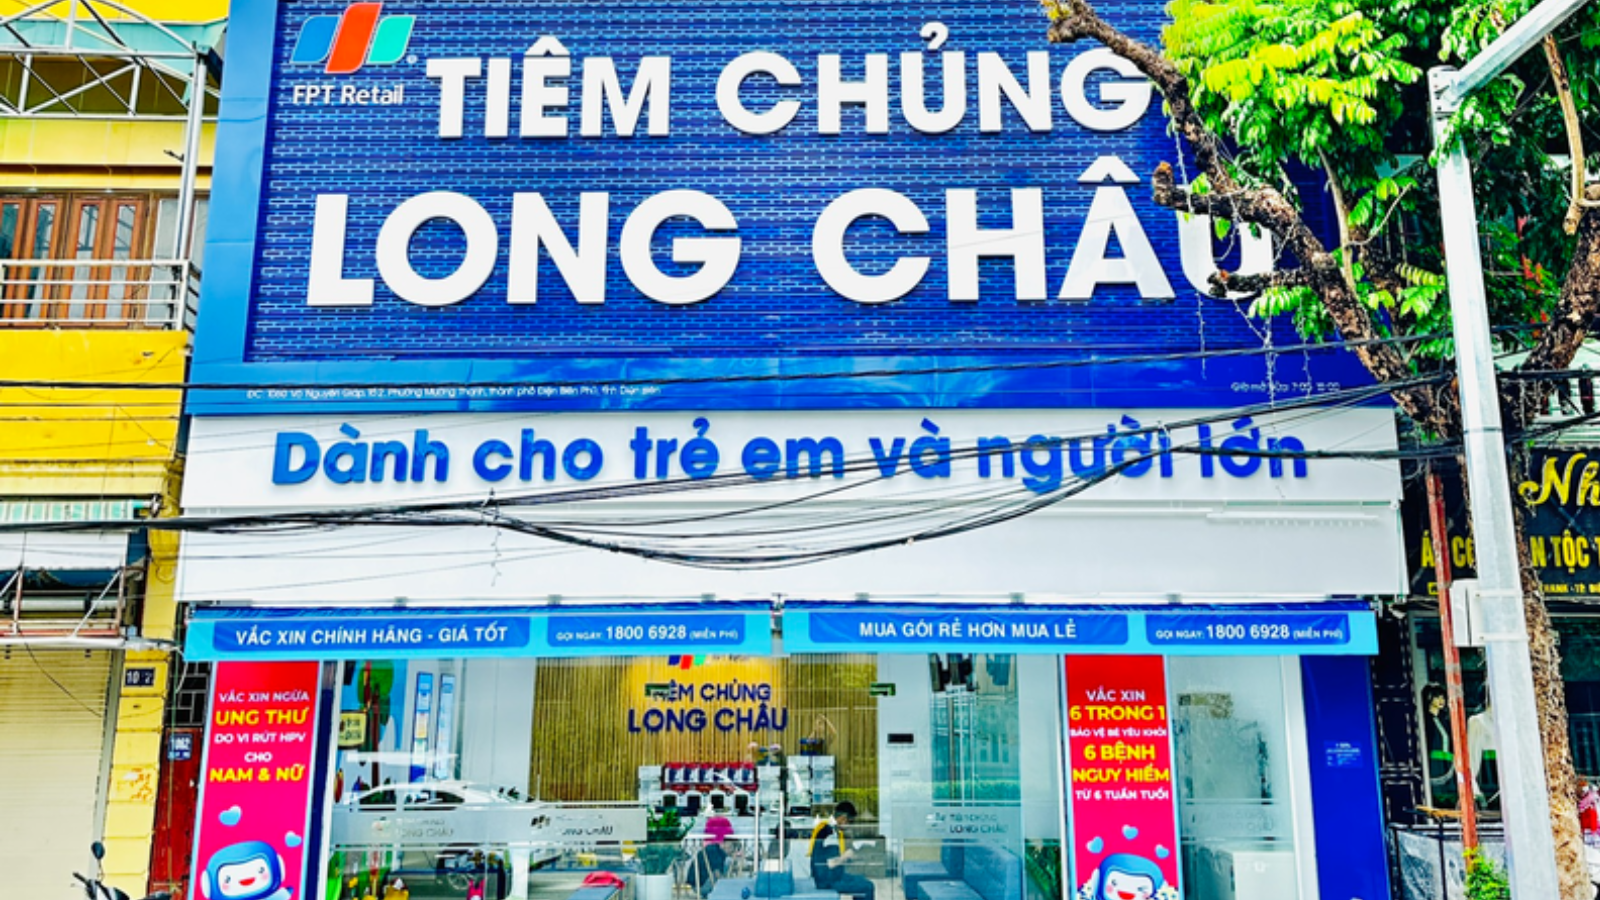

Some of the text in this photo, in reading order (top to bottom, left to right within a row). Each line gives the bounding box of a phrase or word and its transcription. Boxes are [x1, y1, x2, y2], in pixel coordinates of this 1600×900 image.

[426, 21, 1154, 138] TIÊM CHỦNG
[293, 83, 404, 104] FPT Retail
[307, 155, 1273, 307] LONG CHÂU
[272, 414, 1307, 495] Dành cho trẻ em và người lớn
[1551, 529, 1590, 573] TỘC
[236, 622, 272, 645] VẮC
[276, 629, 306, 644] XIN
[311, 626, 366, 644] CHÍNH
[439, 624, 469, 642] GIÁ
[475, 621, 508, 641] TỐT
[606, 625, 644, 640] 1800
[648, 624, 686, 639] 6928
[860, 617, 1076, 638] MUA GÓI RẺ HƠN MUA LẺ
[1206, 624, 1245, 639] 1800
[1250, 624, 1289, 639] 6928
[219, 688, 245, 702] VẮC
[249, 692, 270, 702] XIN
[700, 678, 771, 701] CHỦNG
[1085, 685, 1146, 702] VẮC XIN
[215, 707, 310, 725] UNG THƯ
[628, 703, 788, 732] LONG CHÂU
[1070, 705, 1166, 721] 6 TRONG 1
[214, 730, 306, 744] DO VI RÚT HPV
[244, 751, 273, 762] CHO
[1083, 740, 1155, 764] 6 BỆNH
[210, 763, 306, 782] NAM & NỮ
[1072, 762, 1170, 782] NGUY HIỂM
[1094, 789, 1102, 800] 6
